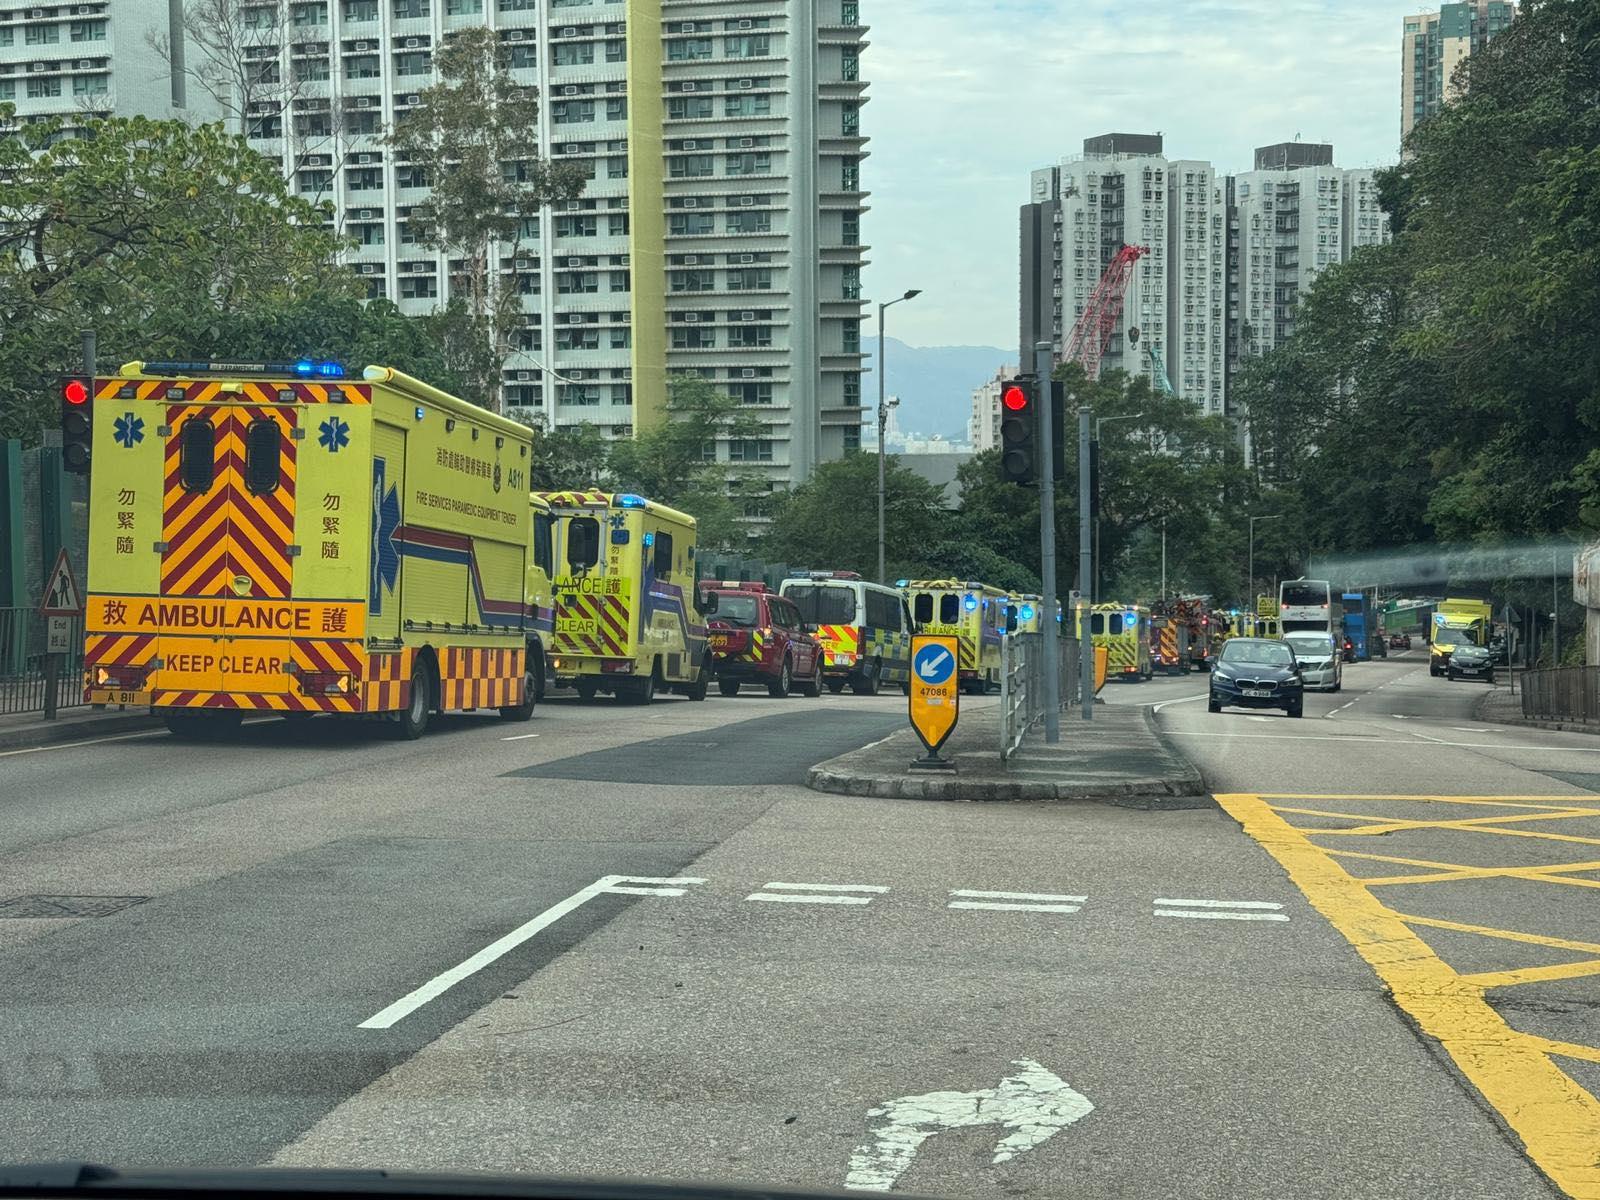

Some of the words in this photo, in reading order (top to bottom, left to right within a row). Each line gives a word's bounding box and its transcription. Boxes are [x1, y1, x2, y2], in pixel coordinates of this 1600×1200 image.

[508, 468, 524, 491] A811
[416, 491, 428, 506] FIRE
[428, 494, 452, 511] SERVICES
[452, 500, 477, 516] PARAMEDIC
[477, 506, 501, 521] EQUIPMENT
[501, 511, 517, 525] TENDER
[54, 620, 66, 630] End
[103, 600, 127, 626] 救
[138, 604, 311, 630] AMBULANCE
[322, 608, 348, 633] 護
[166, 654, 214, 673] KEEP
[218, 655, 281, 675] CLEAR
[107, 692, 115, 702] A
[120, 692, 135, 703] 811
[920, 688, 947, 696] 47086
